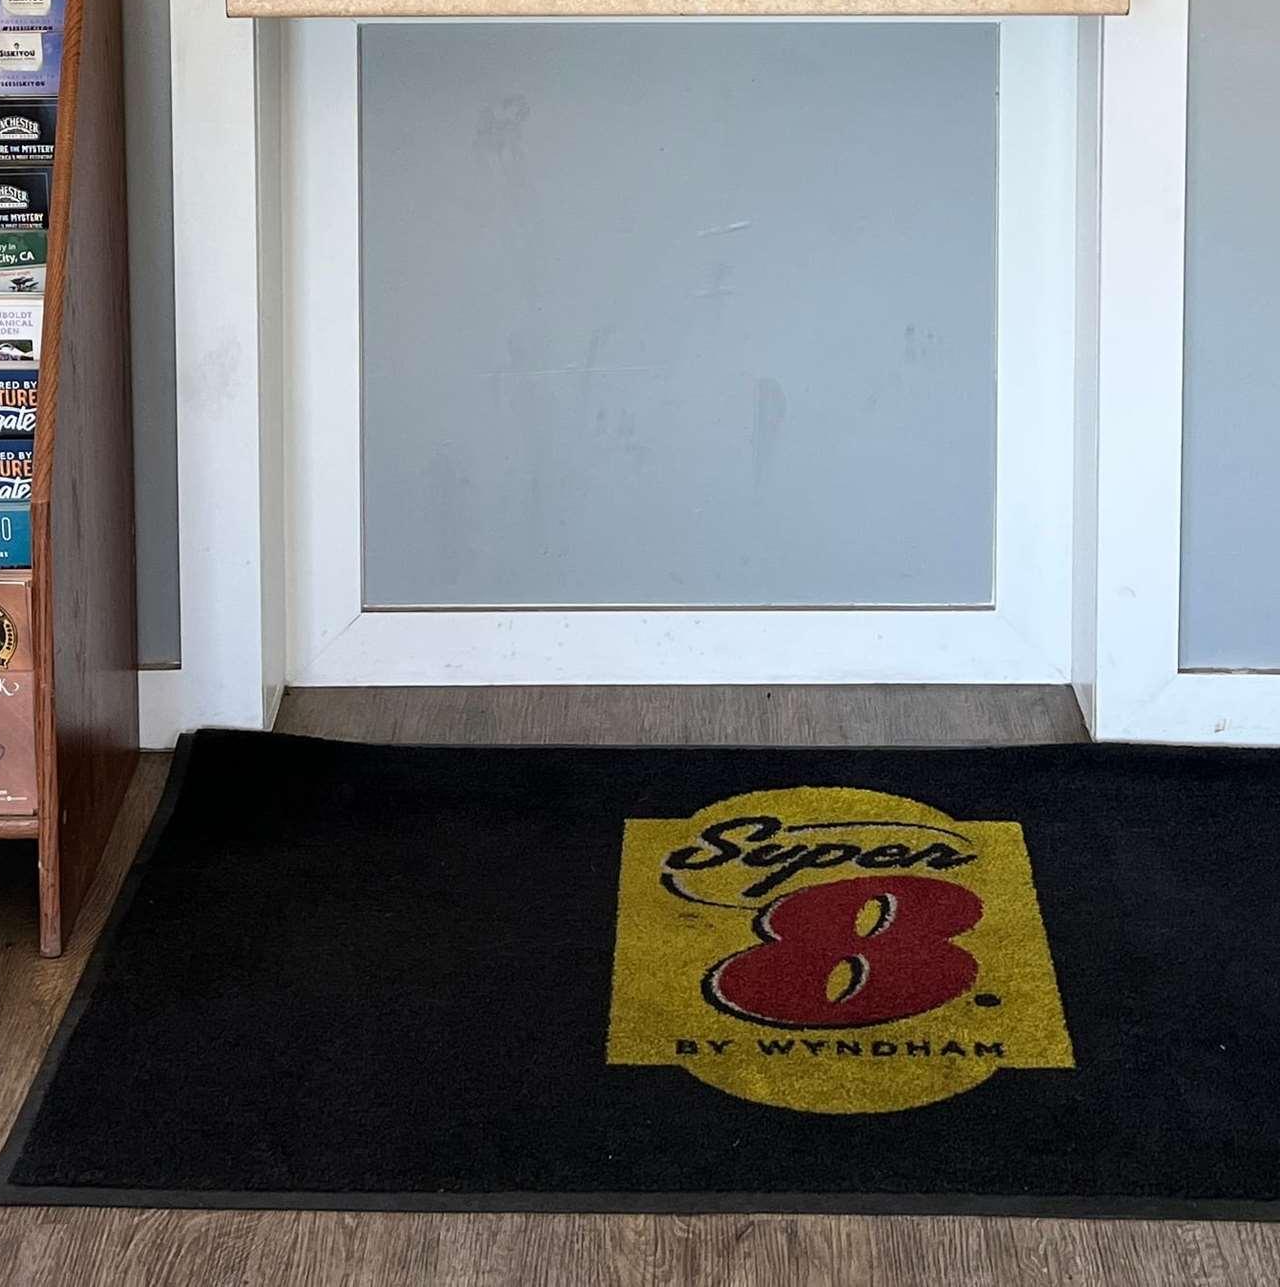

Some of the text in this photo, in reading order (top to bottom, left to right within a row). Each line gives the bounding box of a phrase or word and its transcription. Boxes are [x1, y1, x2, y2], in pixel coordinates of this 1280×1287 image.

[21, 145, 54, 153] MYSTERY
[8, 243, 17, 251] in
[19, 251, 35, 261] CA
[23, 381, 37, 389] BY
[661, 816, 977, 904] Super
[700, 876, 985, 1031] 8
[675, 1039, 1006, 1058] BY WYNDHAM
